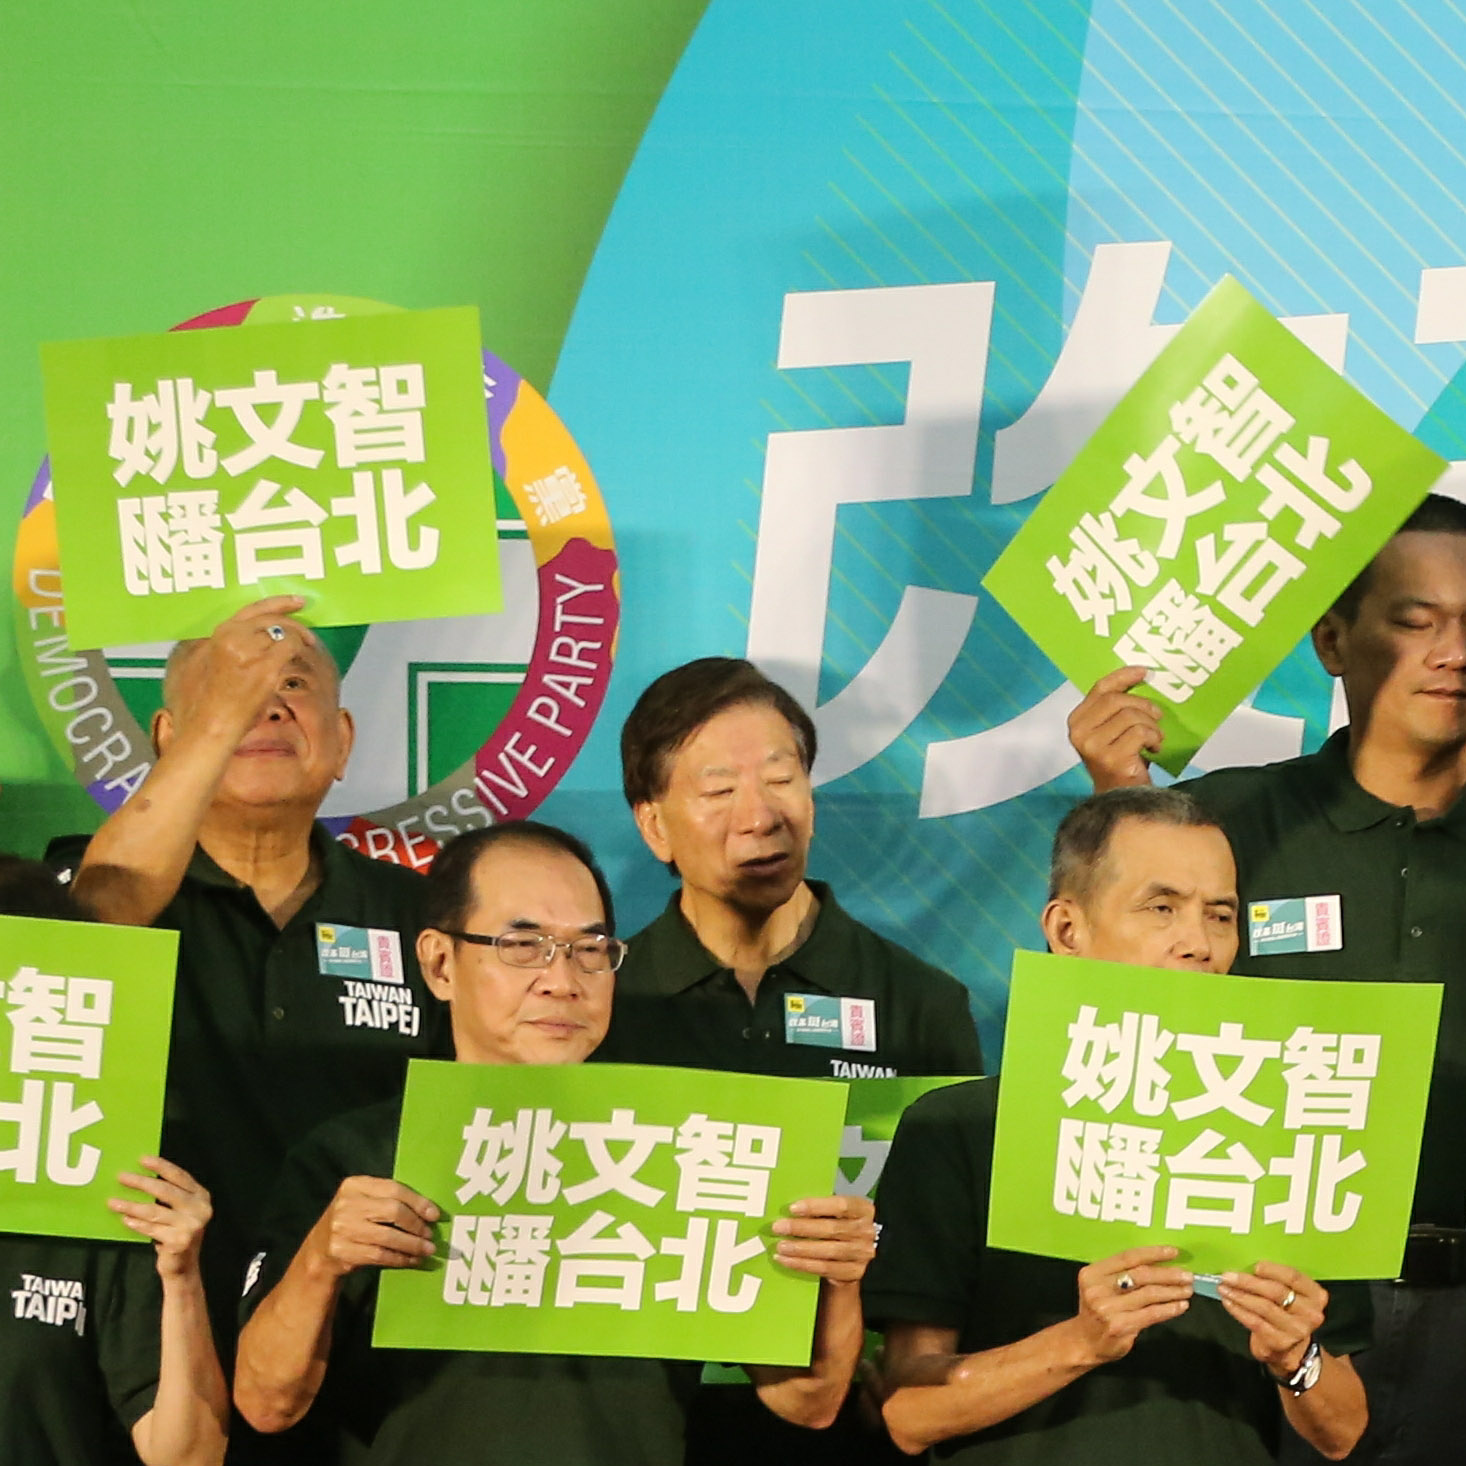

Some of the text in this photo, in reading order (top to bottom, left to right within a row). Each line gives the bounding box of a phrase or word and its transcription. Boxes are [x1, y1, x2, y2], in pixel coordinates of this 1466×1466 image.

[106, 363, 426, 488] 姚文智
[1051, 351, 1299, 637] 姚文智
[526, 573, 604, 737] PARTY
[338, 995, 420, 1037] TAIPEI
[342, 980, 413, 1005] TAIWAN
[1060, 1004, 1383, 1131] 姚文智
[454, 1107, 781, 1218] 姚文智
